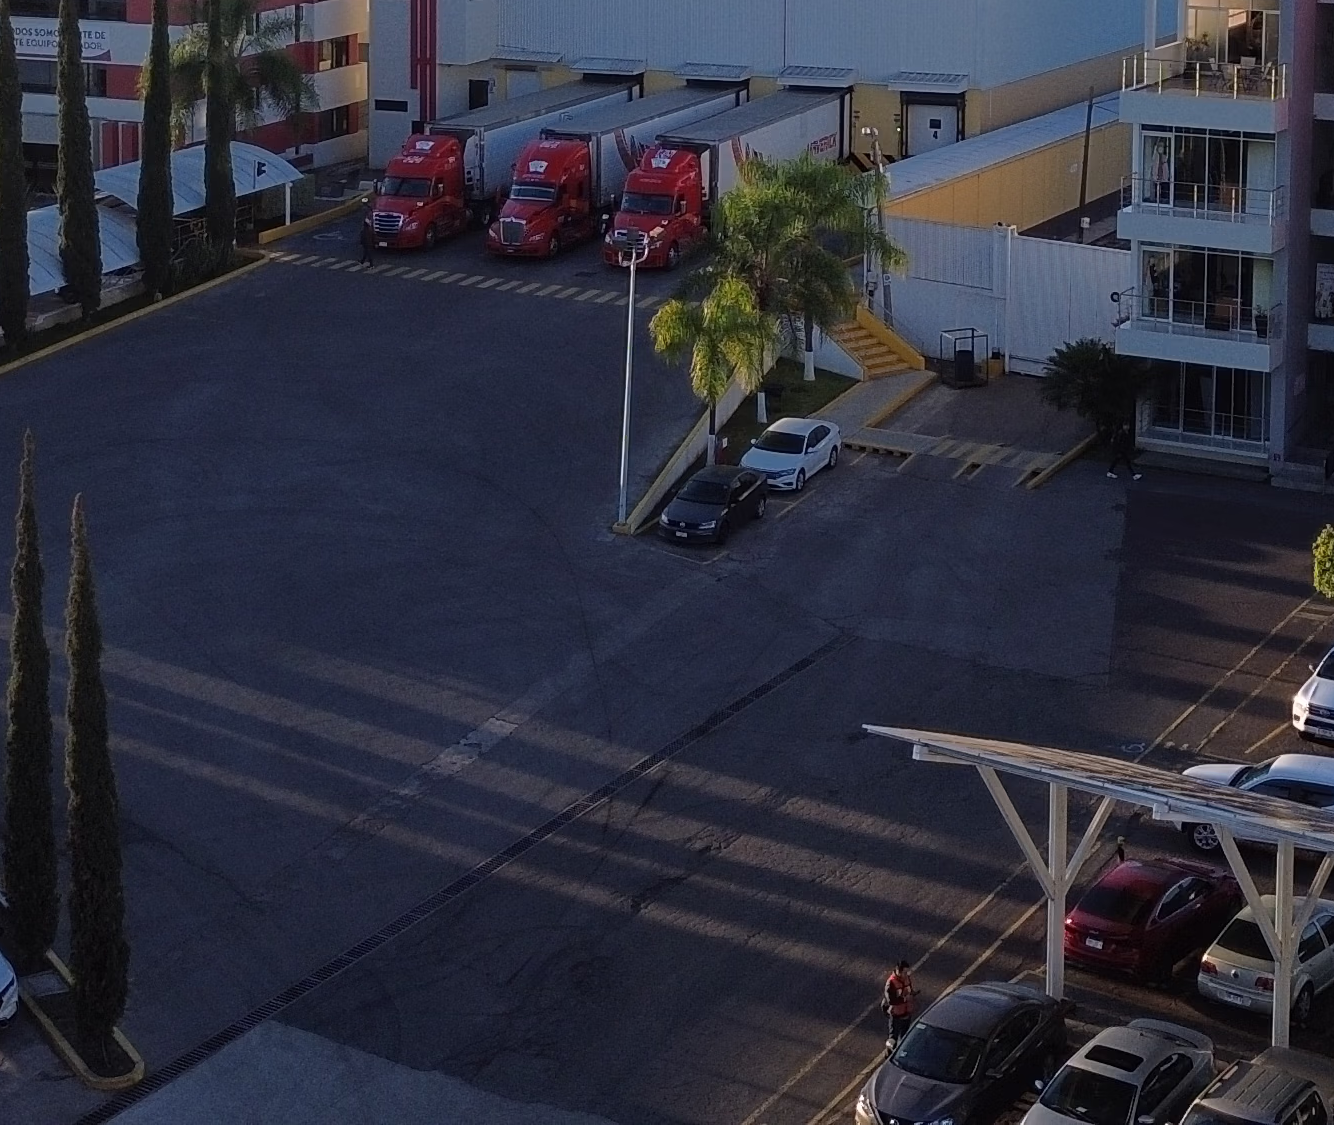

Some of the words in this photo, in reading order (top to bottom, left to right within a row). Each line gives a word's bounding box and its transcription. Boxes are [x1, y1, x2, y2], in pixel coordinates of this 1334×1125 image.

[15, 27, 33, 36] DOS
[94, 31, 106, 40] DE
[26, 38, 58, 48] EQUIPO
[932, 130, 938, 140] 4
